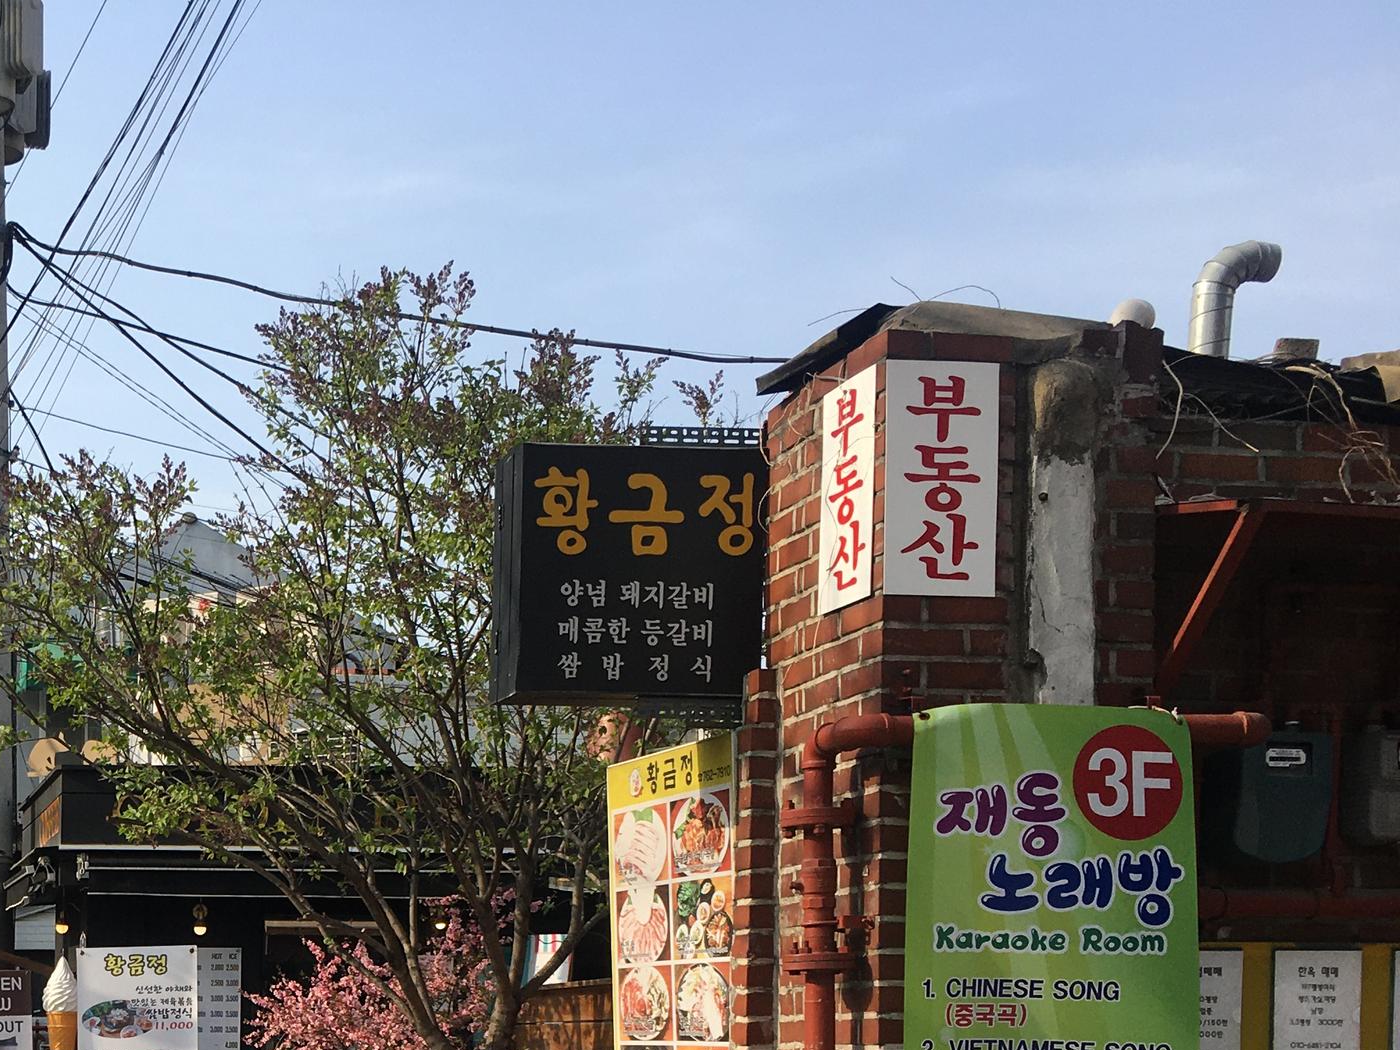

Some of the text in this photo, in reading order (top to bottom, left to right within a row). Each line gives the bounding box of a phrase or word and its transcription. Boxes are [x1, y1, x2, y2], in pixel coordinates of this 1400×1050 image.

[829, 389, 866, 592] 부동산
[901, 375, 981, 581] 부동산
[534, 465, 755, 557] 황금정
[560, 580, 715, 611] 양념 돼지갈비
[558, 619, 714, 648] 매콤한 등갈비
[646, 750, 694, 794] 황금정
[1088, 748, 1174, 817] 3F
[936, 772, 1066, 857] 재동
[981, 849, 1182, 926] 노래방
[936, 926, 1165, 952] Karaoke Room
[104, 953, 168, 976] 황금정
[136, 984, 193, 994] 신선한 야채와
[922, 979, 1120, 1001] 1. CHINESE SONG
[145, 1008, 193, 1020] 쌈밥정식
[154, 1021, 194, 1031] 11,000
[945, 1004, 1027, 1027] (중국곡)
